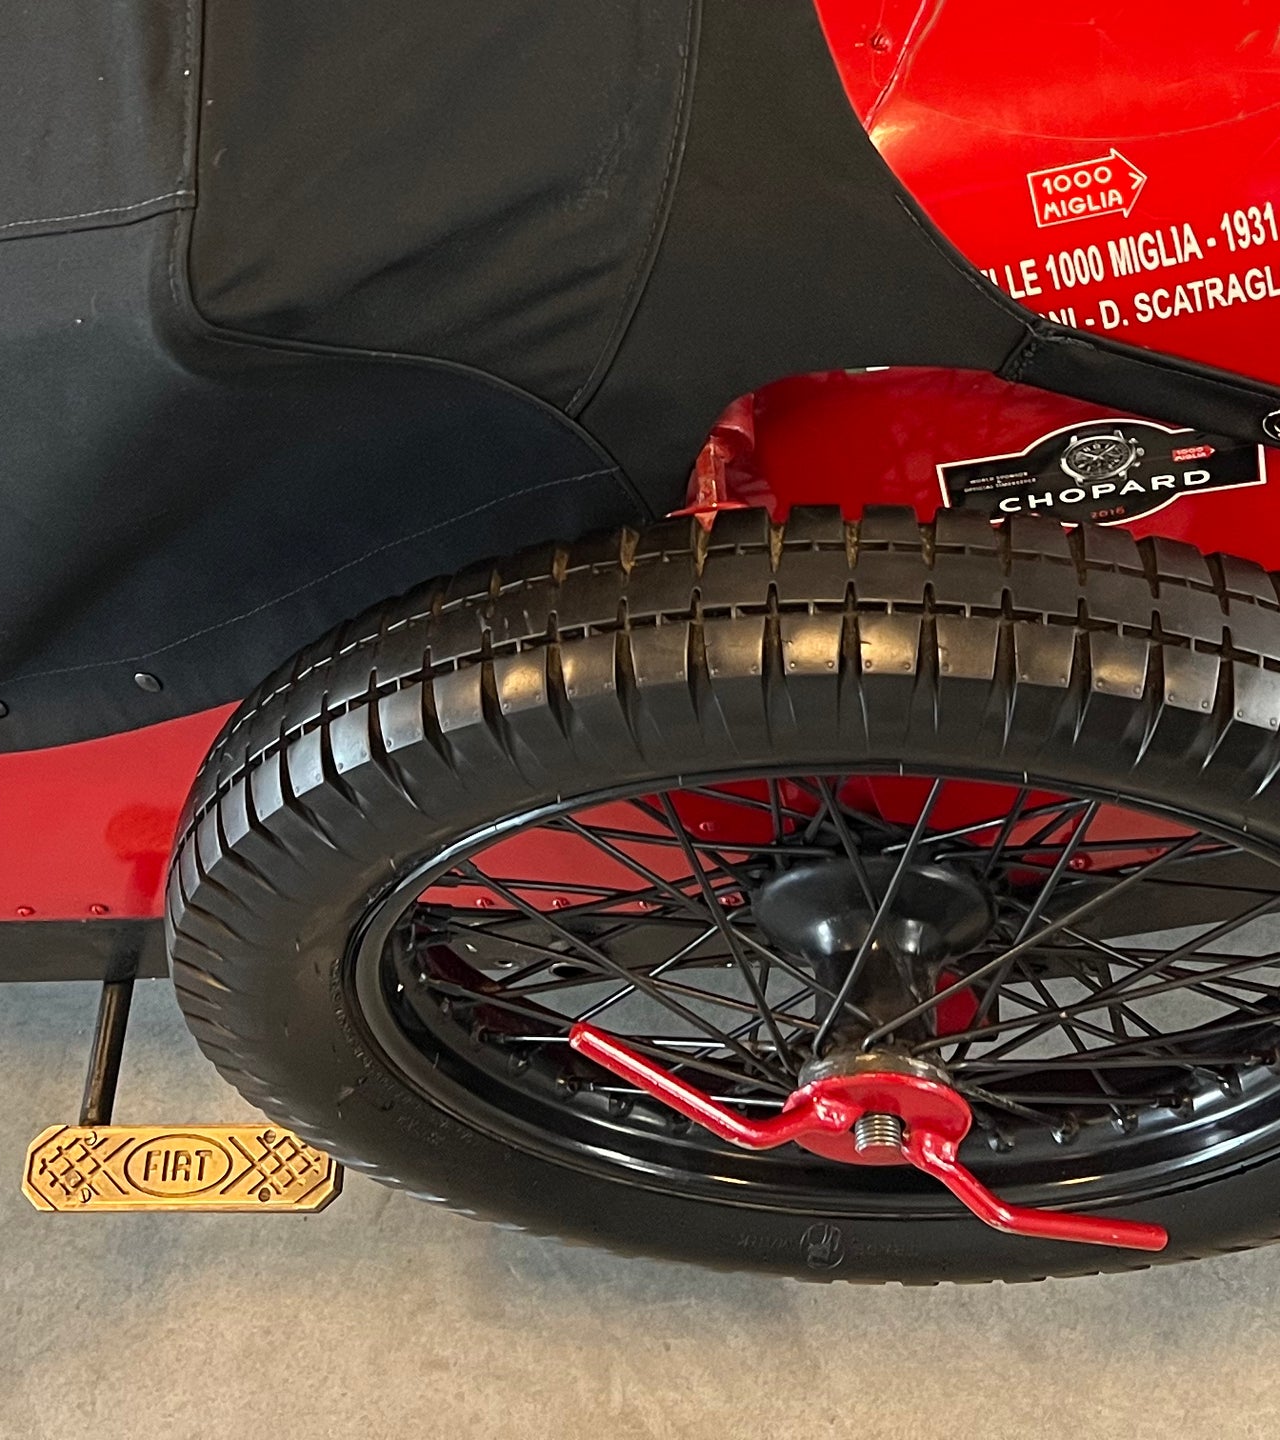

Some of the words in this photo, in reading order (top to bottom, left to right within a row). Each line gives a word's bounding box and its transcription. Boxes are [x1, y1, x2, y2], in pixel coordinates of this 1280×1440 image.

[1042, 166, 1112, 195] 1000
[1044, 189, 1123, 220] MIGLIA
[1045, 245, 1105, 290] 1000
[1107, 223, 1204, 277] MIGLIA
[1221, 201, 1279, 252] 1931
[1100, 300, 1129, 330] D.
[999, 469, 1211, 513] CHOPARD
[143, 1149, 213, 1182] FIAT
